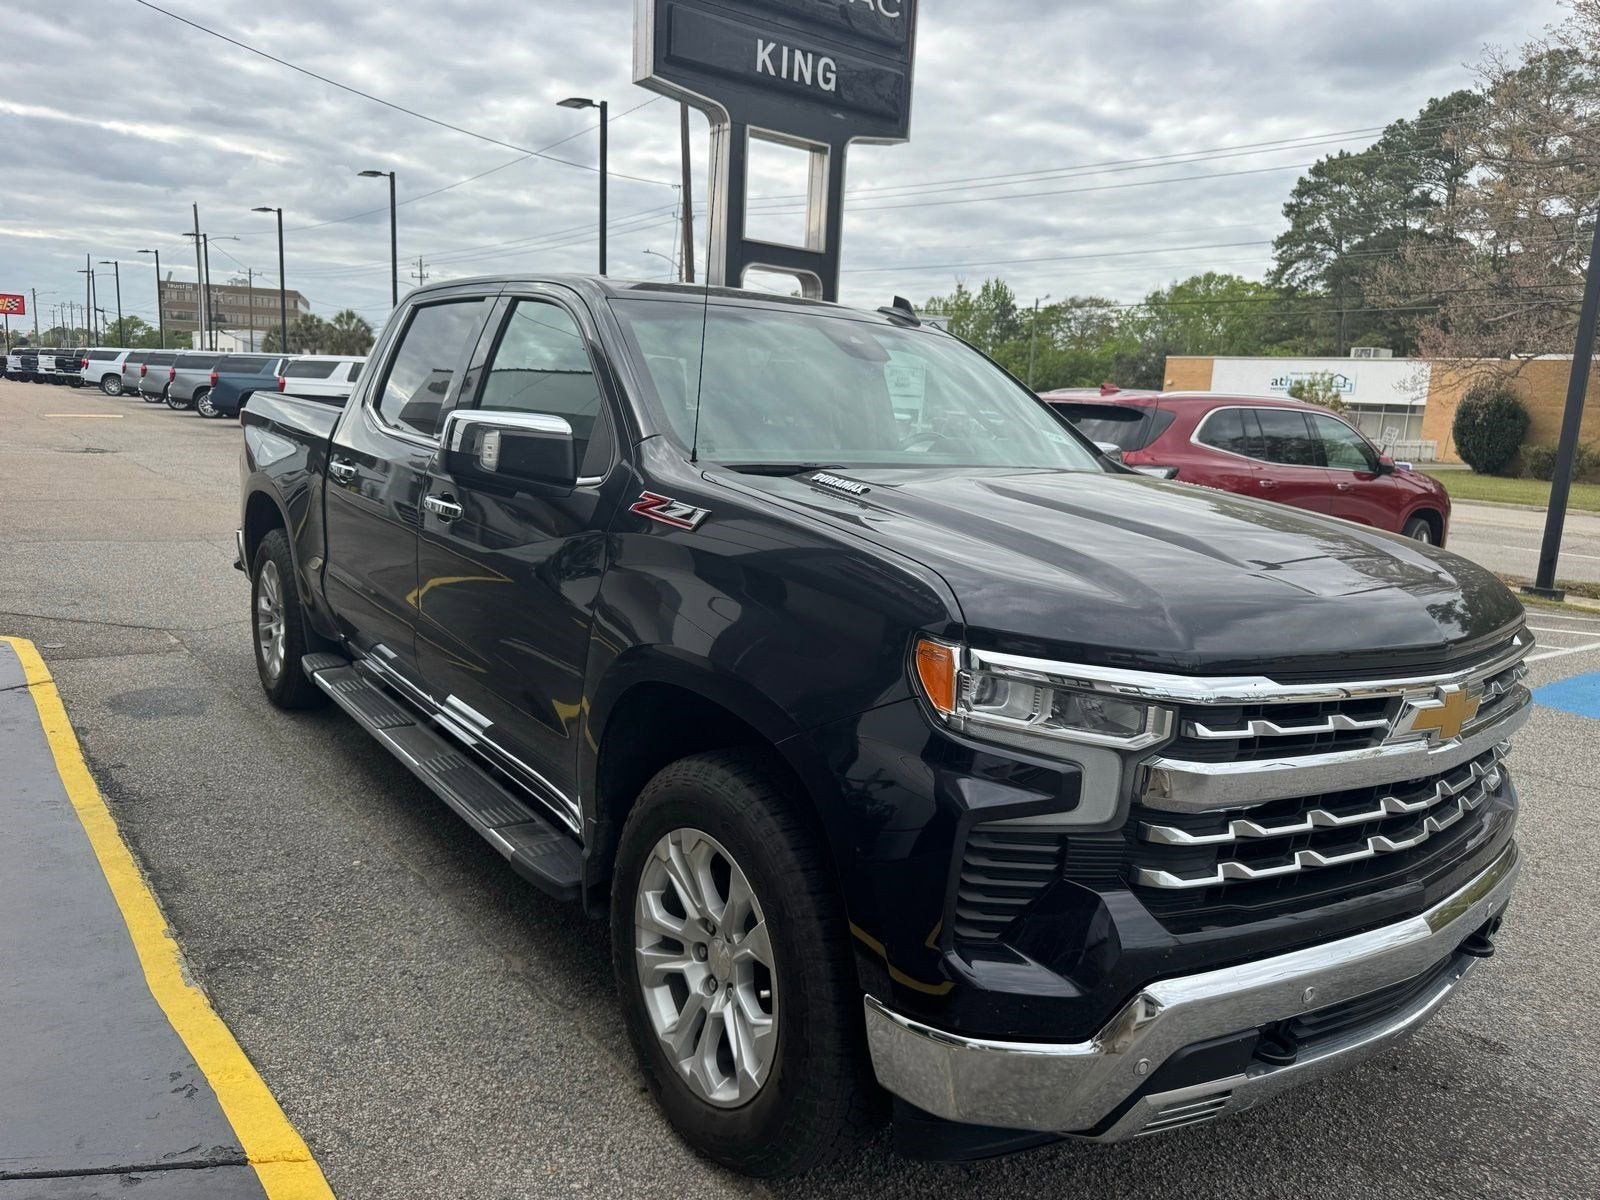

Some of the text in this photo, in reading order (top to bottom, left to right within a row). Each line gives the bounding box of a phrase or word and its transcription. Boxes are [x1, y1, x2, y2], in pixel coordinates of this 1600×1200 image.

[757, 39, 837, 92] KING
[811, 472, 868, 496] DURAMAX
[628, 490, 712, 530] Z71
